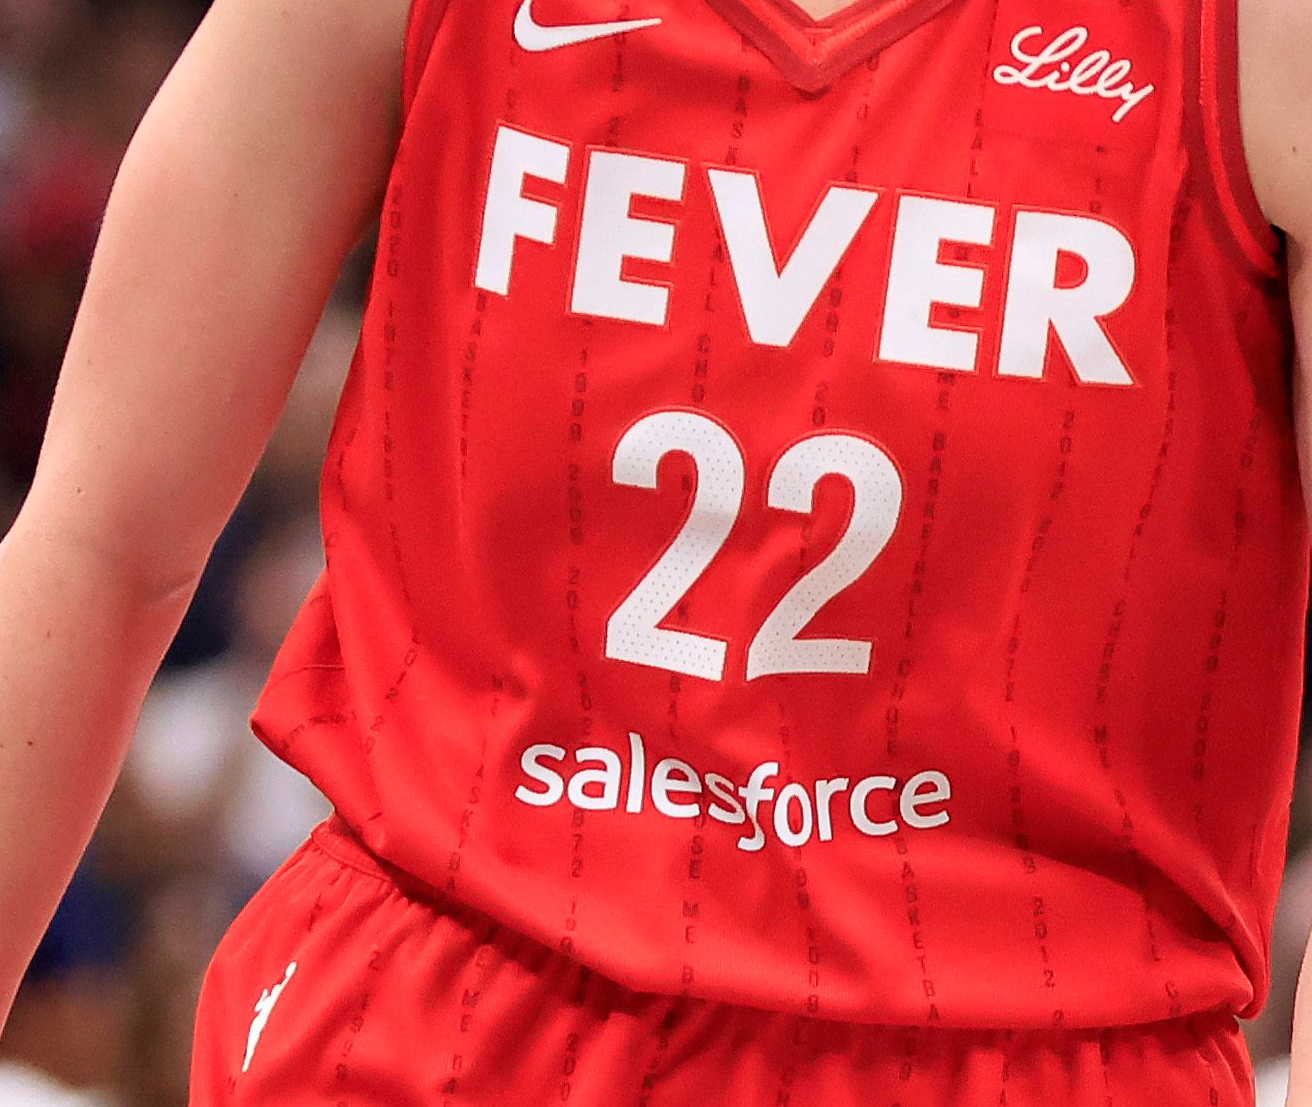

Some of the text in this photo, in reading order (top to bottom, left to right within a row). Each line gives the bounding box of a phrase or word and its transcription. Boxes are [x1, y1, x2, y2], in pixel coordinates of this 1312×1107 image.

[993, 25, 1155, 123] Lilly
[475, 126, 1137, 384] FEVER
[606, 410, 903, 682] 22
[515, 732, 951, 851] salesforce
[681, 898, 701, 944] ME
[1031, 895, 1057, 989] 2012
